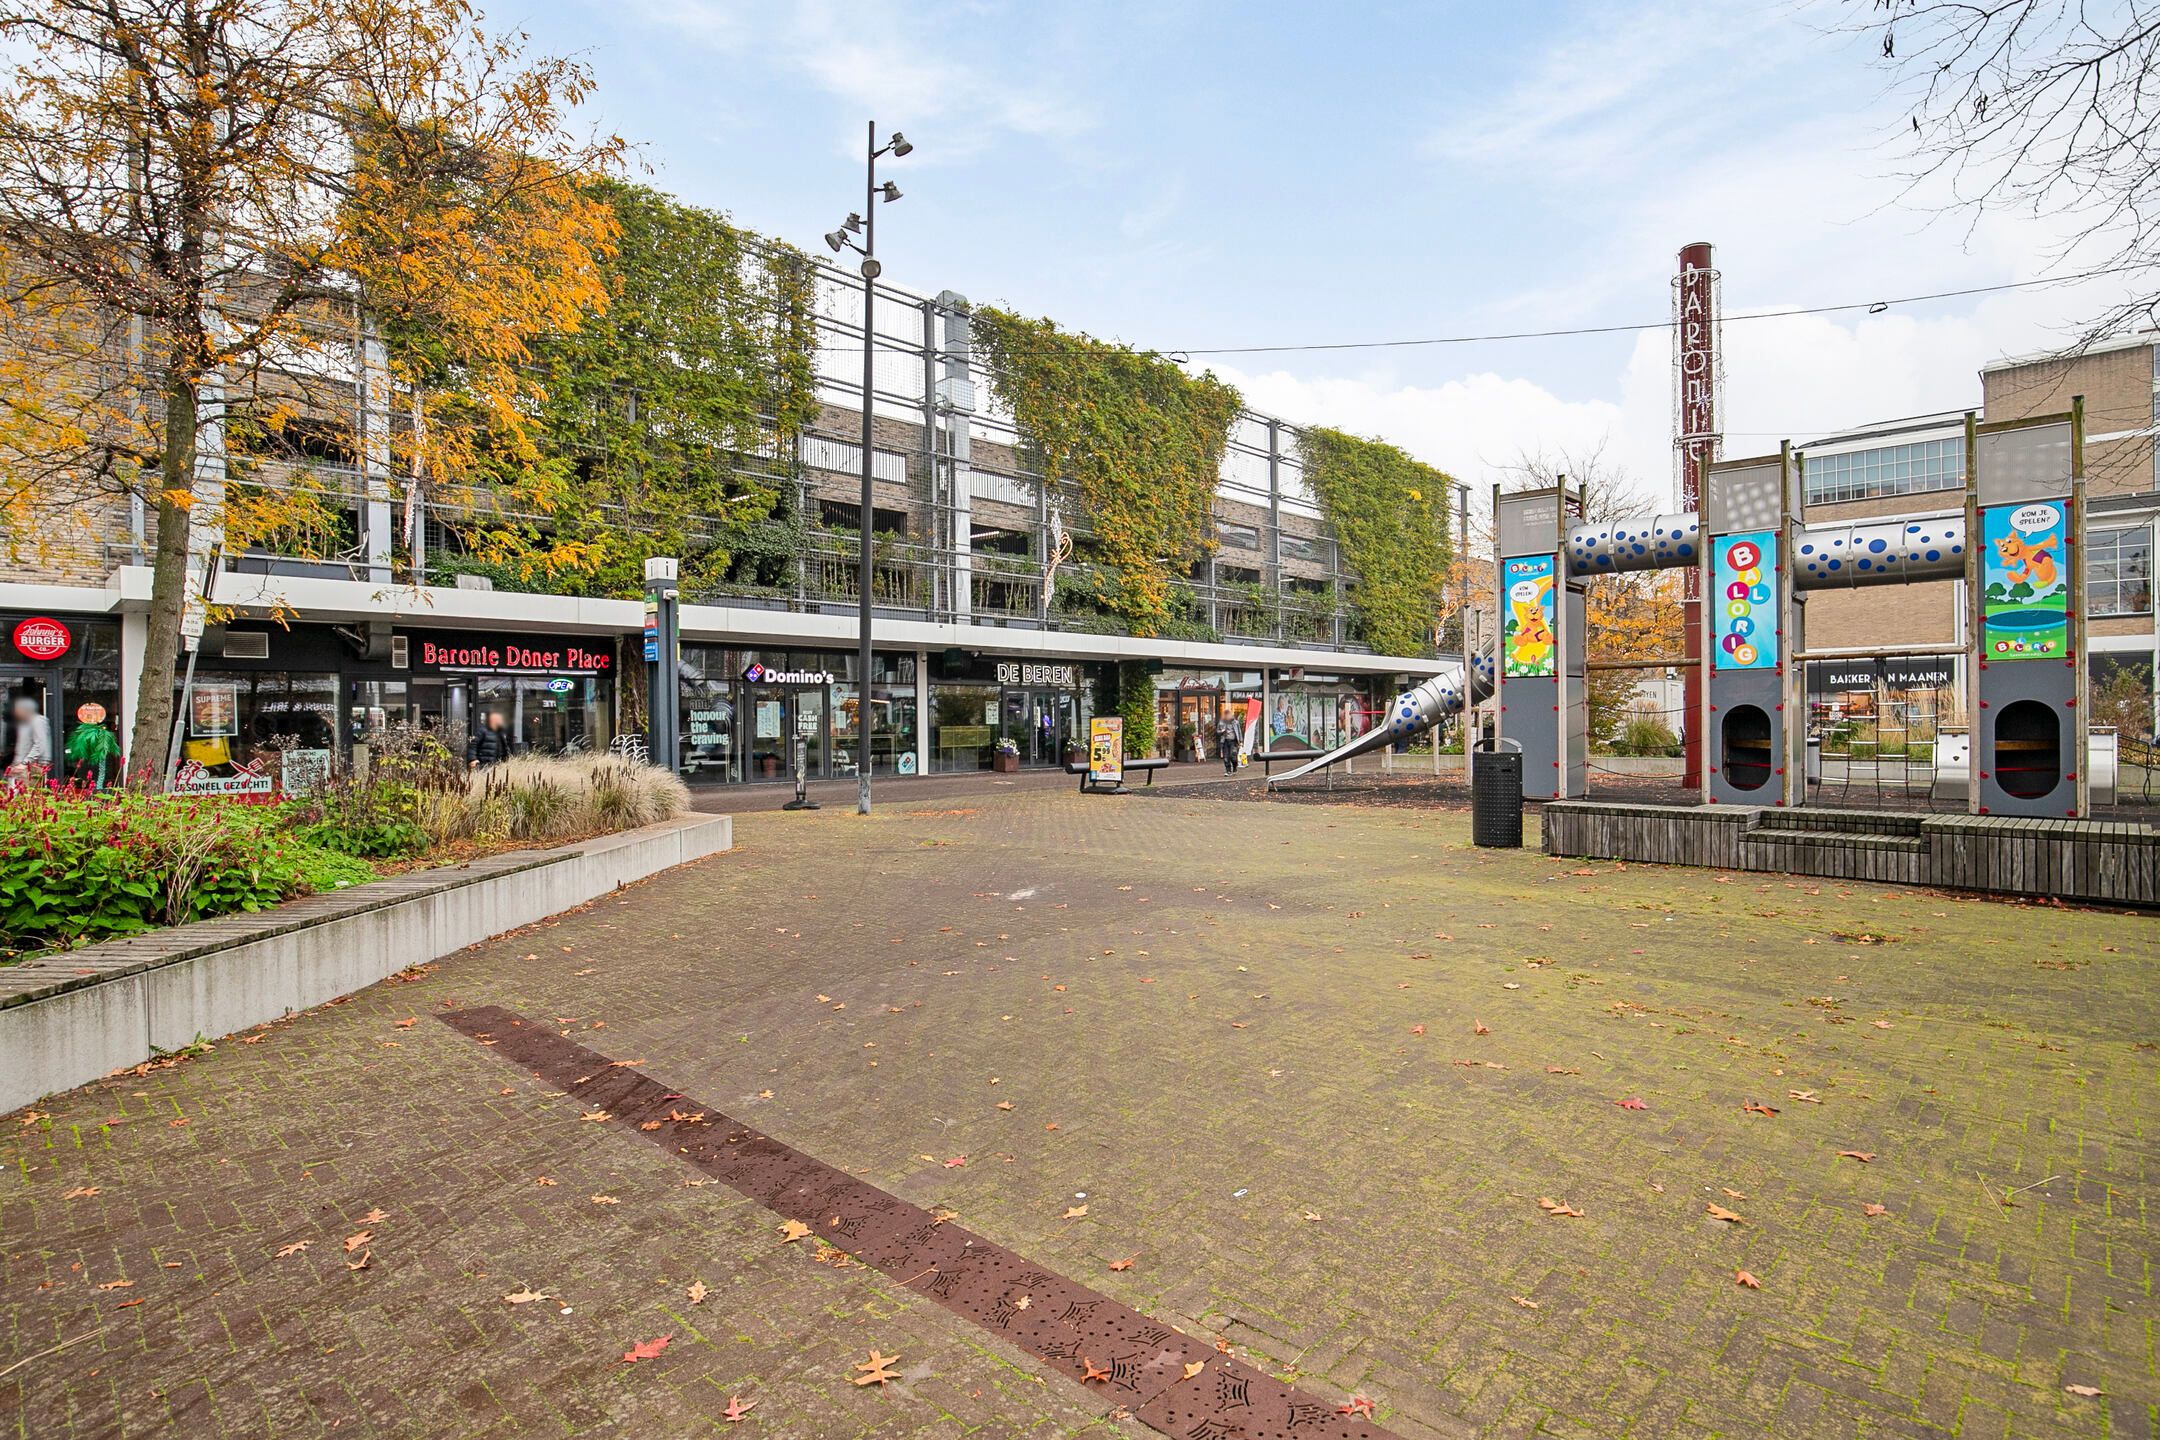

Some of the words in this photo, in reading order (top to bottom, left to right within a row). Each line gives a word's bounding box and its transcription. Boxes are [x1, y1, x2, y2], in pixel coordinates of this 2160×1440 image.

[1682, 262, 1707, 462] BARONIE
[2019, 516, 2051, 526] SPELEN?
[21, 625, 64, 637] Johnny's
[21, 636, 65, 646] BURGER
[423, 642, 500, 667] Baronie
[506, 645, 560, 668] Döner
[567, 648, 611, 669] Place
[765, 668, 834, 684] Domino's
[997, 663, 1020, 682] DE
[1022, 664, 1073, 684] BEREN
[1830, 674, 1871, 684] BAKKER
[1899, 671, 1948, 682] MAANEN
[549, 680, 575, 691] OPEN
[195, 693, 232, 704] SUPREME
[690, 710, 727, 721] honour
[798, 714, 818, 722] CASH
[691, 722, 708, 733] the
[798, 722, 818, 730] FREE
[691, 733, 729, 746] craving
[174, 781, 221, 793] ERSONEEL
[224, 780, 269, 791] GEZCHT!
